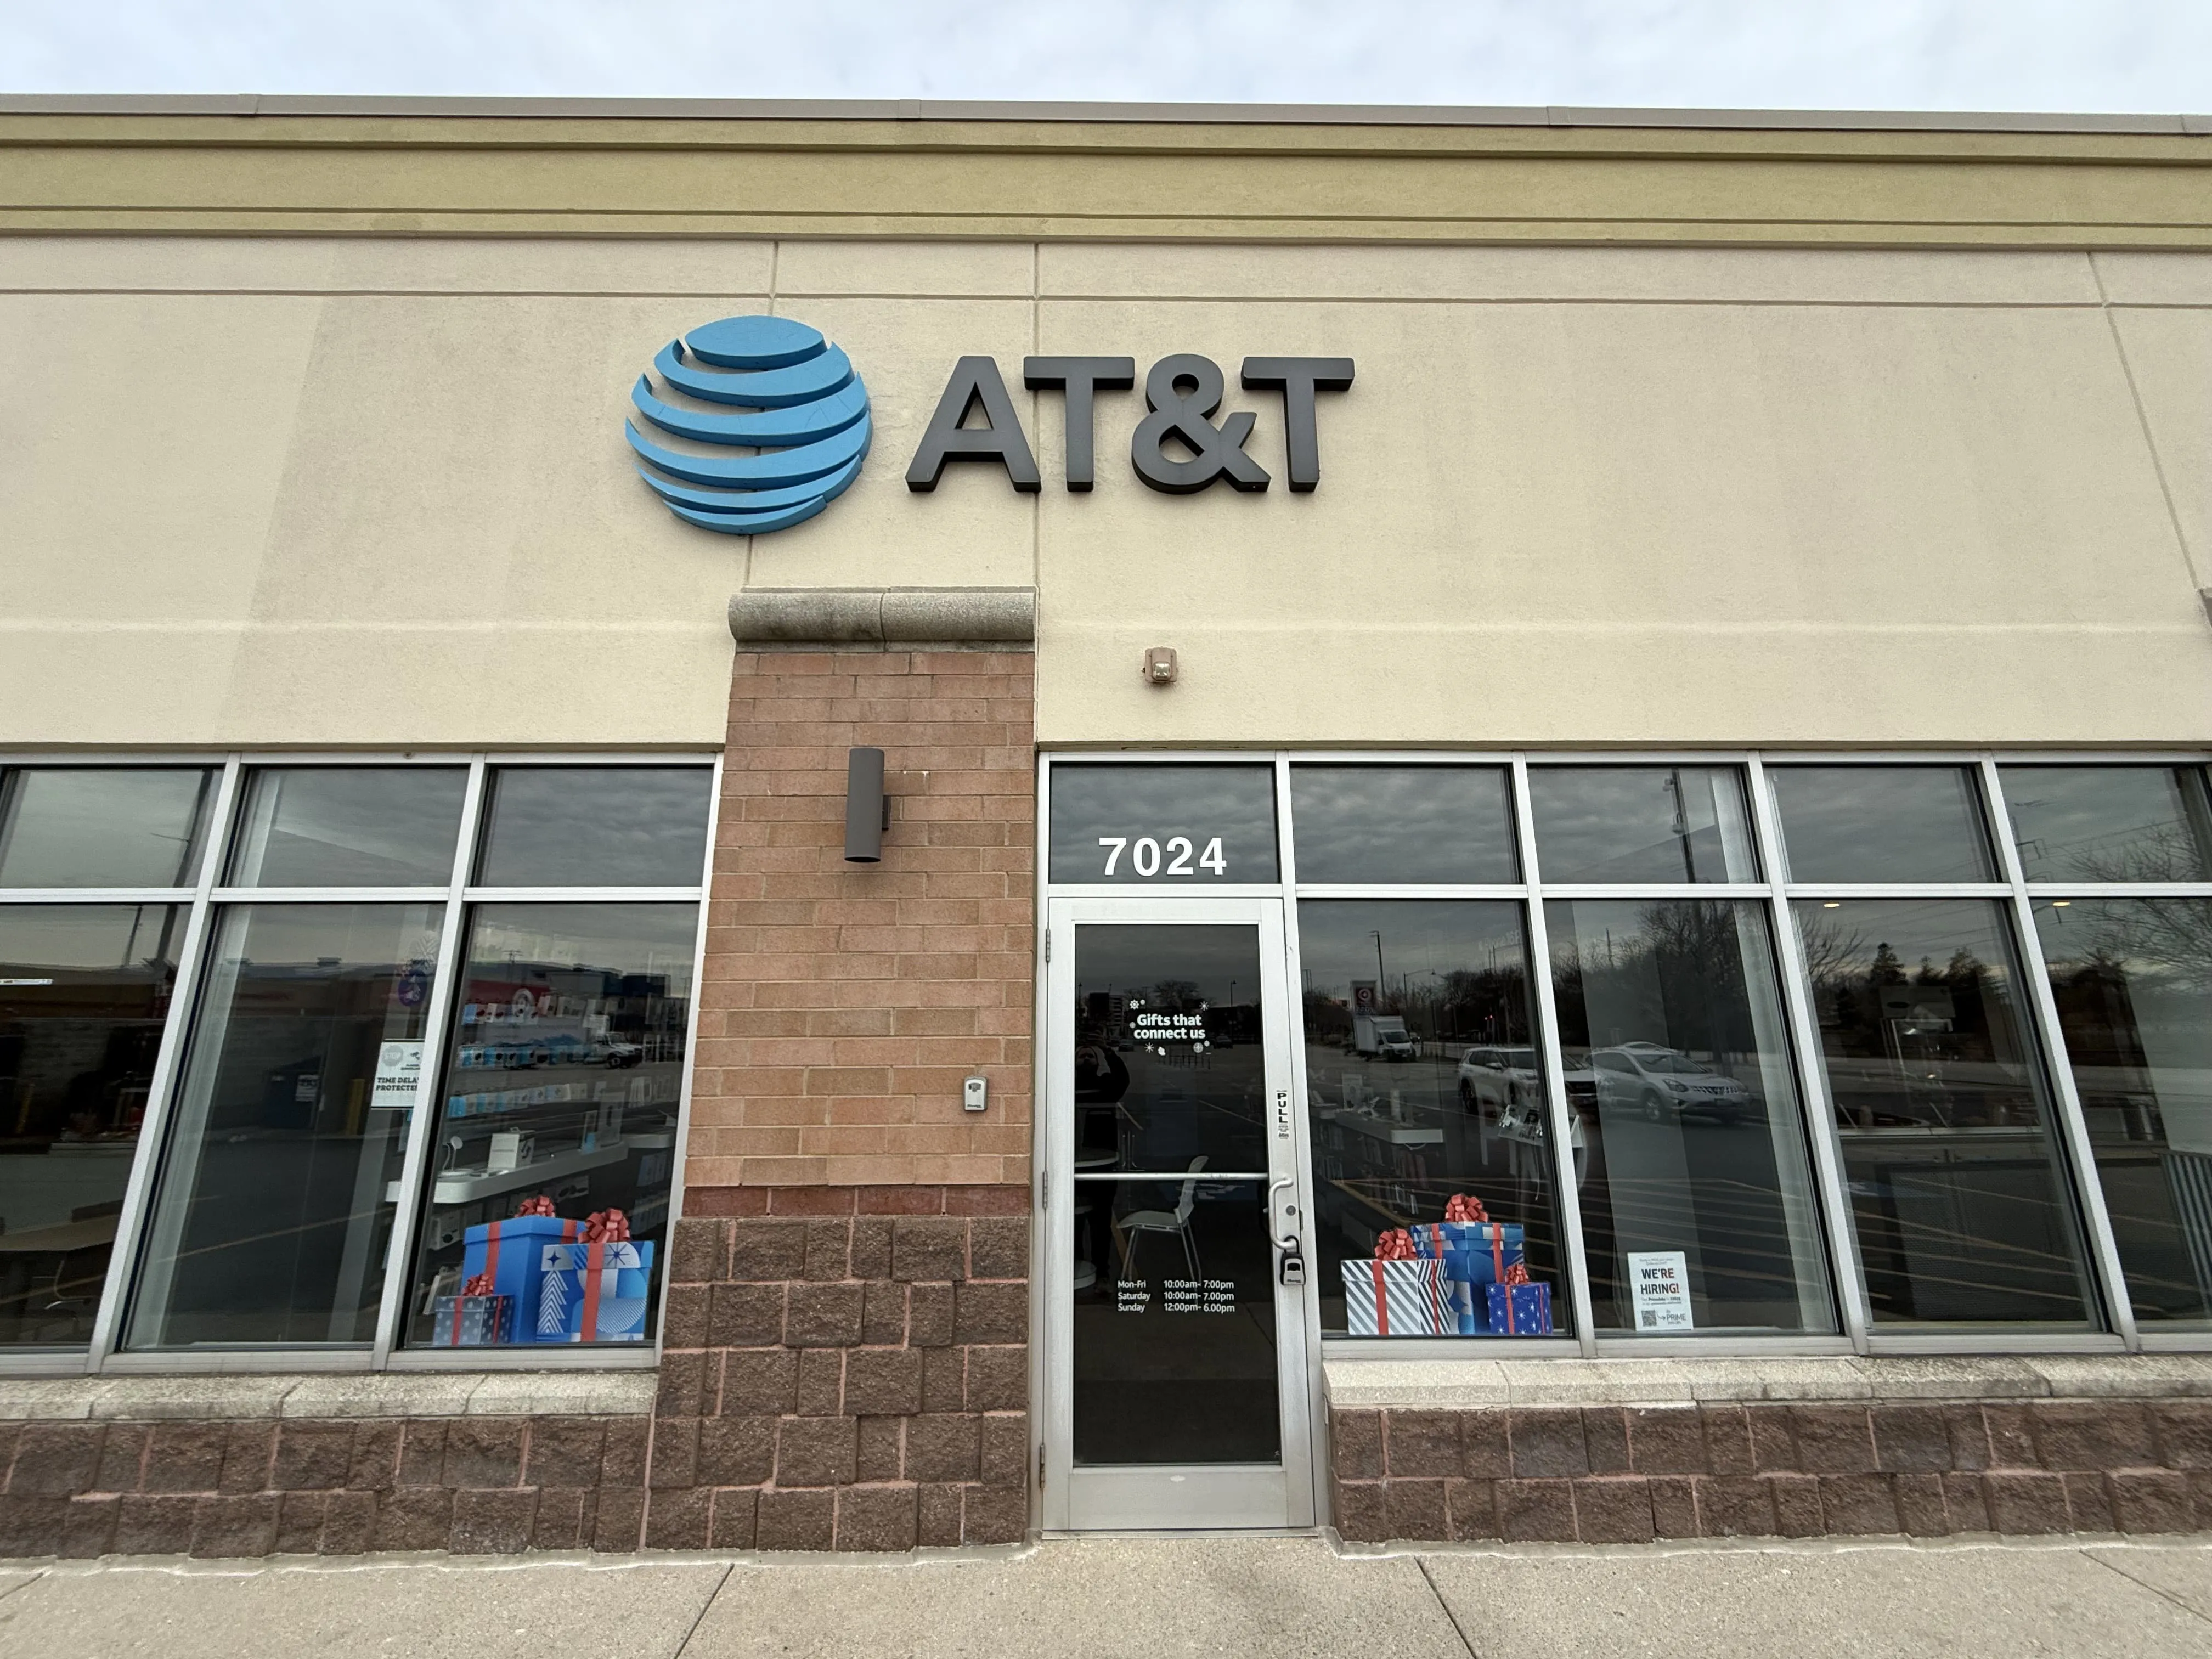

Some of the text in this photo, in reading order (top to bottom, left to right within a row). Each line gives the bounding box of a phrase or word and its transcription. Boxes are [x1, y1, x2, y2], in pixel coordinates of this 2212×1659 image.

[905, 353, 1355, 495] AT&T
[1098, 837, 1227, 877] 7024
[1137, 1013, 1202, 1026] Gifts that
[1133, 1028, 1206, 1039] connect us
[1277, 1093, 1288, 1124] PULL
[1641, 1268, 1675, 1280] WE'RE
[1203, 1280, 1234, 1290] 7:00pm
[1640, 1283, 1680, 1295] HIRING!
[1118, 1291, 1151, 1301] Saturday
[1118, 1303, 1146, 1313] Sunday
